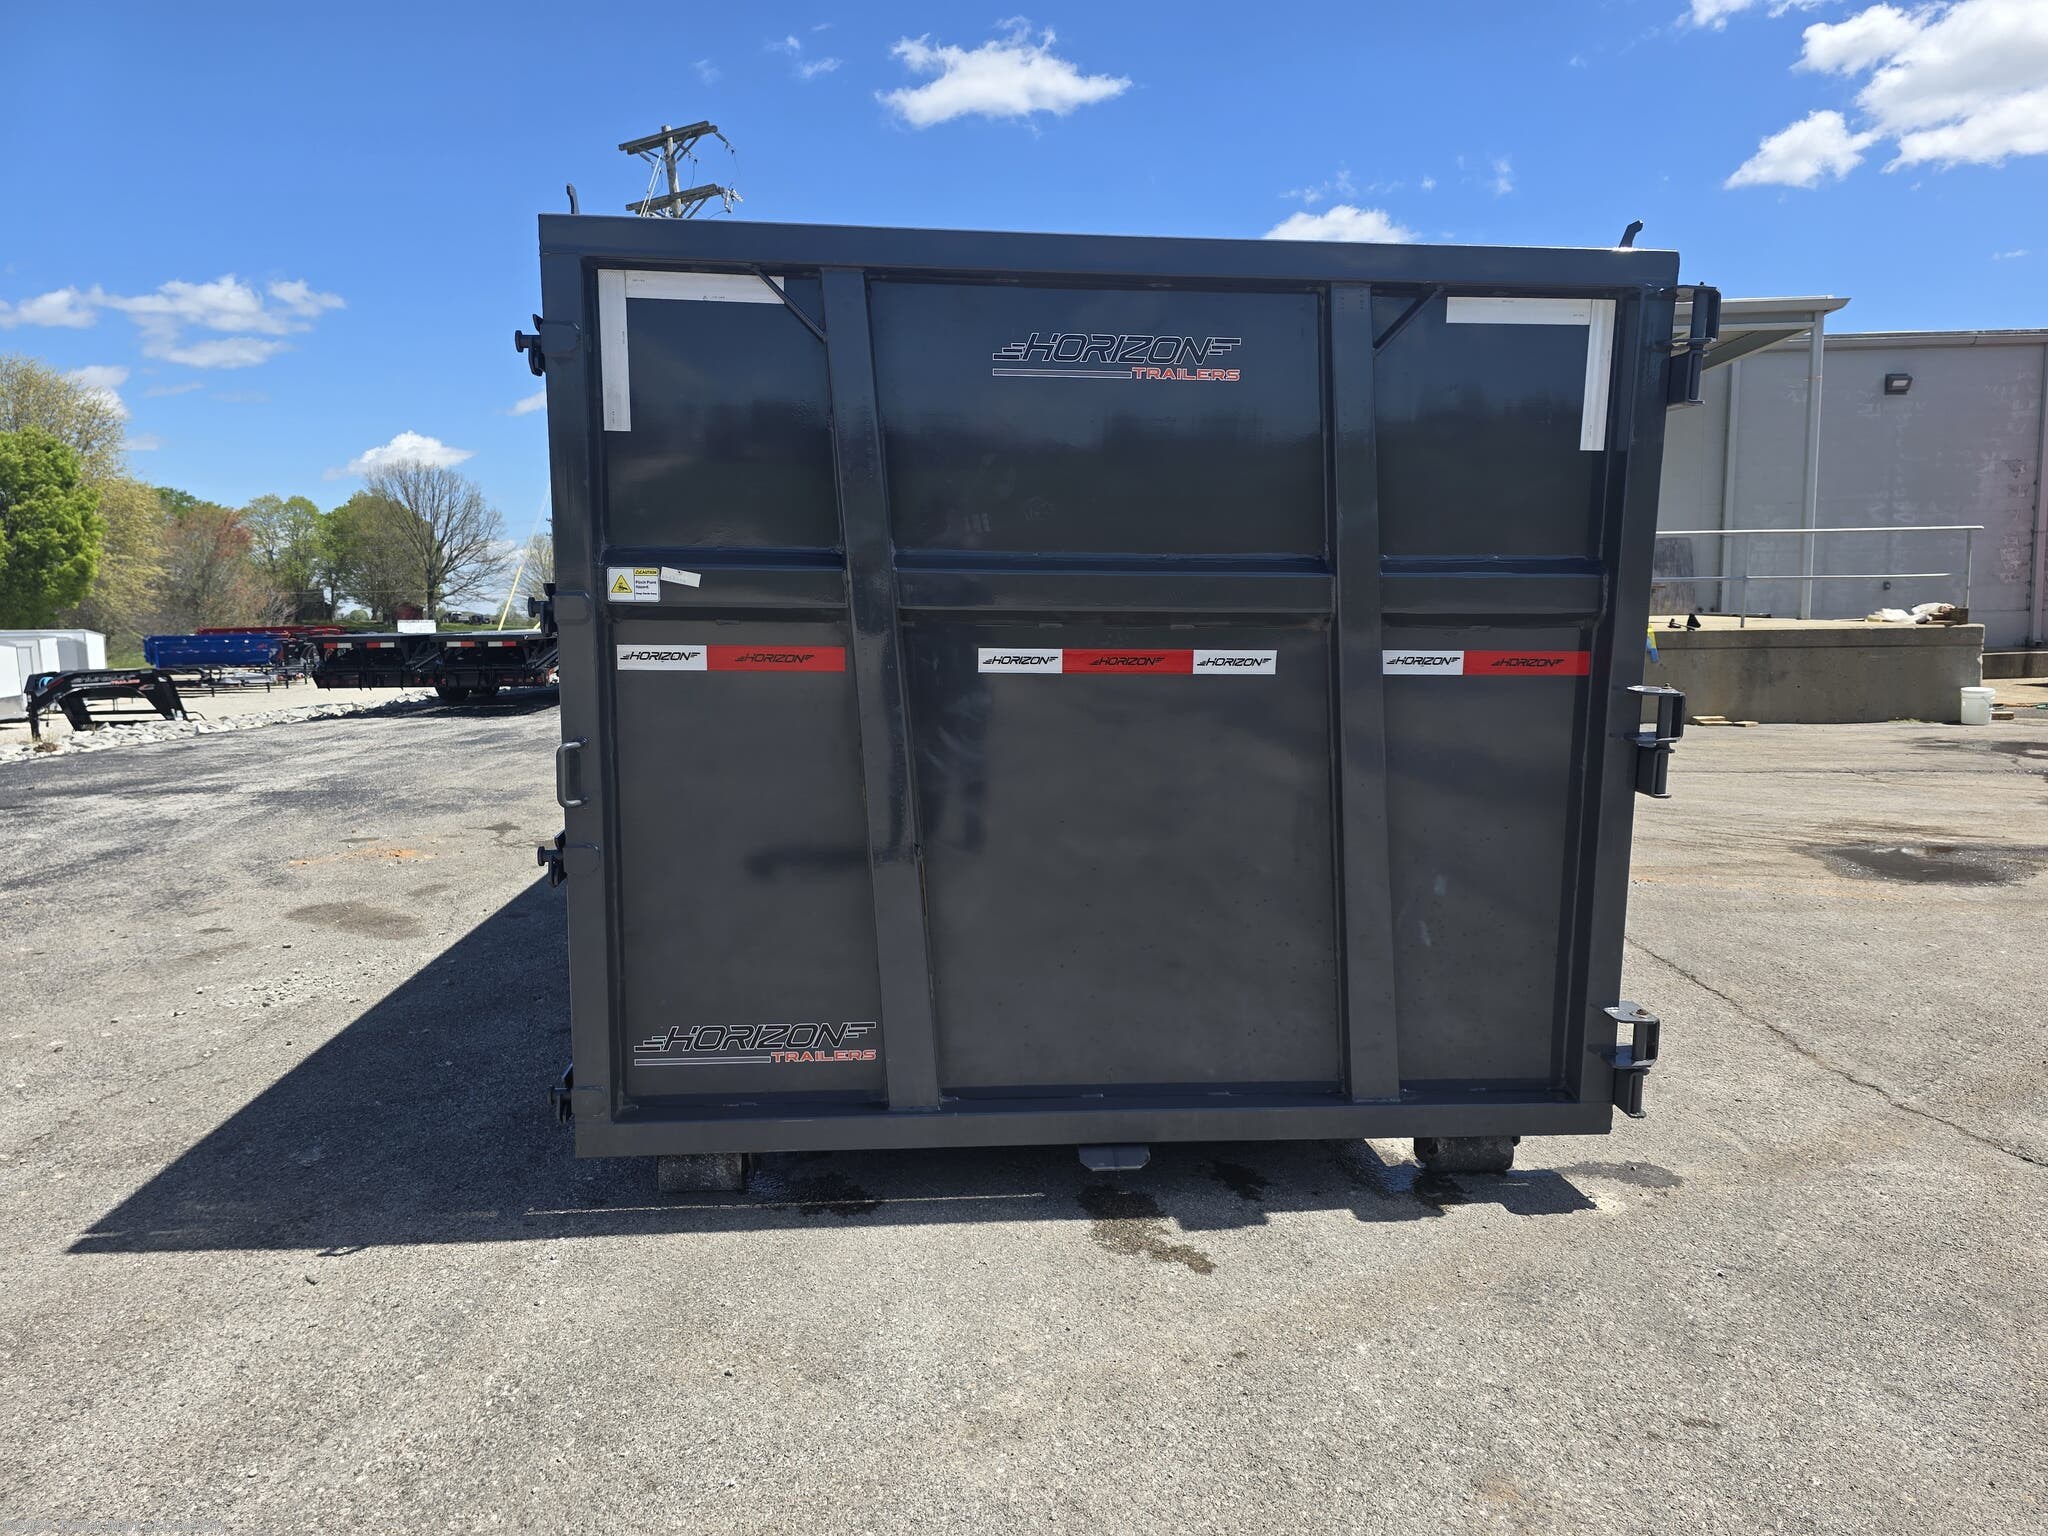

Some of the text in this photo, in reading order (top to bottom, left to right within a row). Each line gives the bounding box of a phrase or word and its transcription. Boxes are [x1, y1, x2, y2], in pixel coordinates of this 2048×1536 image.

[1022, 332, 1213, 365] HORIZON
[1131, 366, 1241, 382] TRAILERS
[629, 651, 807, 663] HORIZON HORIZON
[991, 655, 1265, 667] HORIZON HORIZON HORIZON
[1394, 656, 1558, 667] HORIZON HORIZON
[662, 1022, 850, 1051] HORIZON
[771, 1049, 876, 1063] TRAILERS
